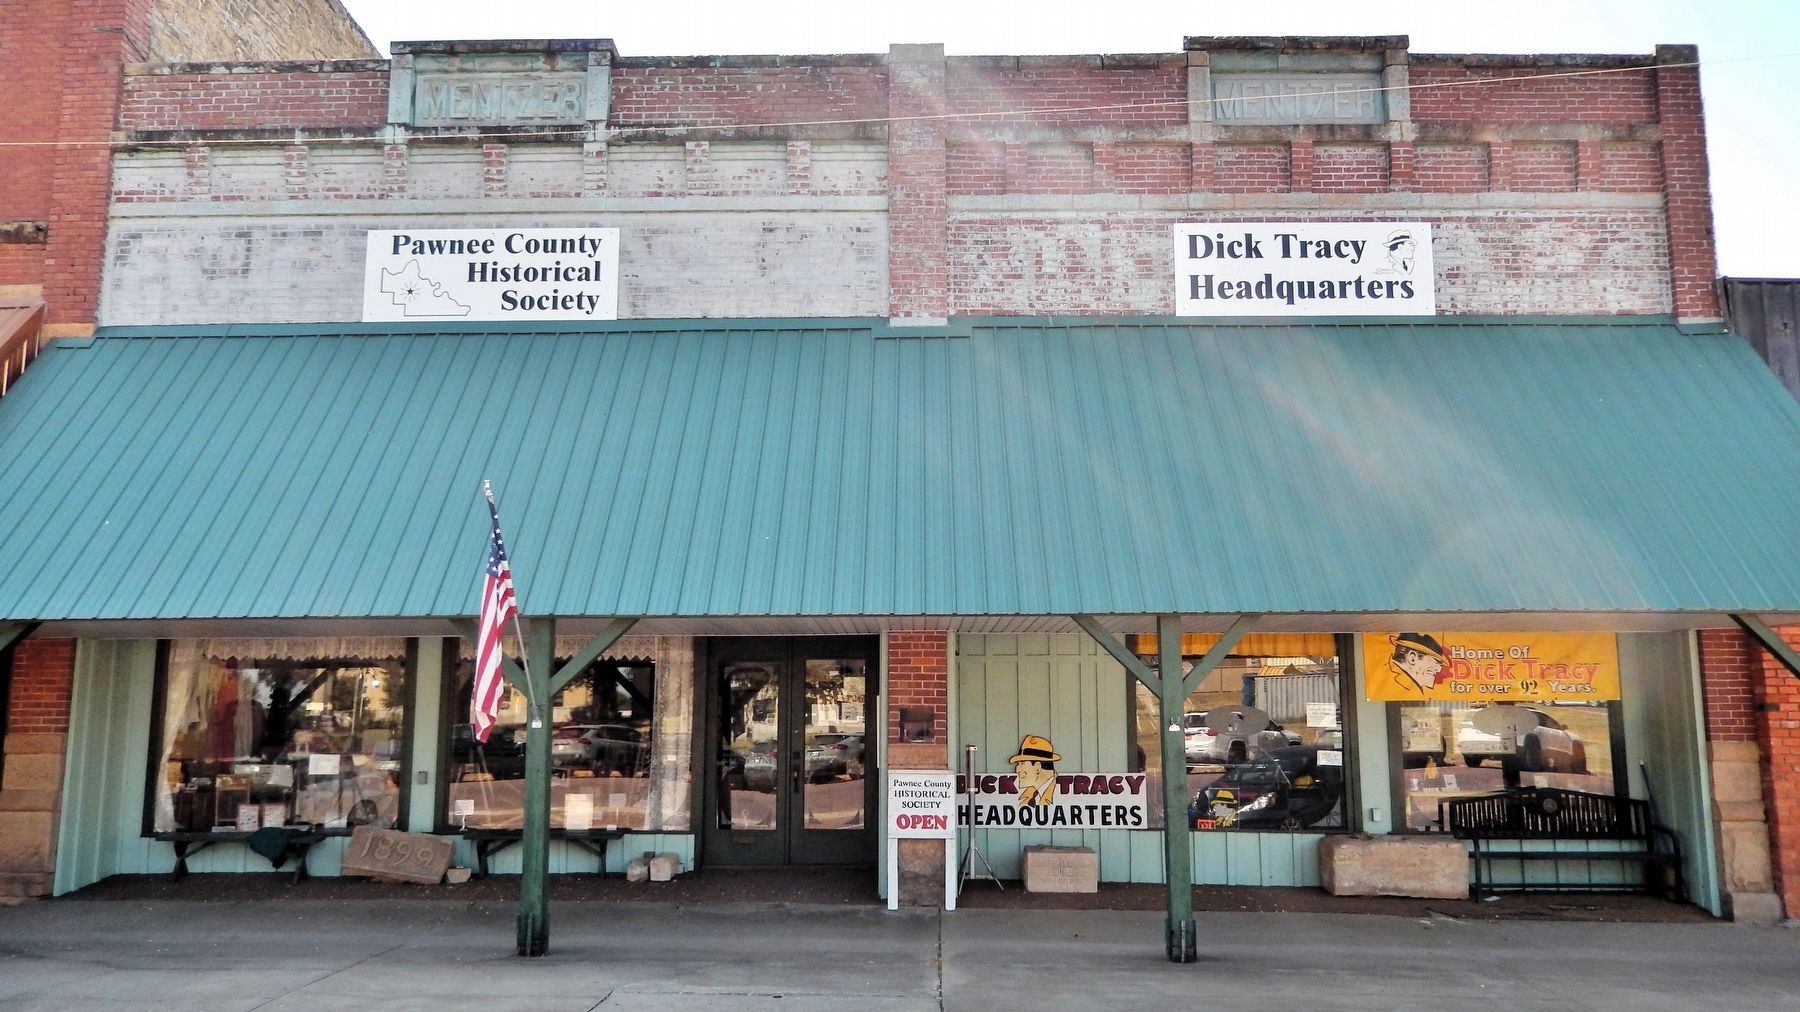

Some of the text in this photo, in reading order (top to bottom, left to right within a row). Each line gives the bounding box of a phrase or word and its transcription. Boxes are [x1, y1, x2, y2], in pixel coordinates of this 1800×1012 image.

[1213, 81, 1378, 120] MENTZER
[391, 233, 603, 258] Pawnee County
[1187, 232, 1367, 265] Dick Tracy
[467, 260, 602, 283] Historical
[1188, 273, 1415, 306] Headquarters
[501, 289, 600, 315] Society
[1450, 645, 1529, 659] Home Of
[1452, 657, 1600, 685] Dick Tracy
[1450, 679, 1597, 695] for over 92 Years.
[893, 779, 952, 790] Pawnee County
[894, 790, 951, 799] HISTORICAL
[1056, 775, 1146, 795] TRACY
[902, 801, 942, 809] SOCIETY
[957, 804, 1144, 827] HEADQUARTERS
[896, 814, 948, 830] OPEN
[360, 831, 435, 868] 1899
